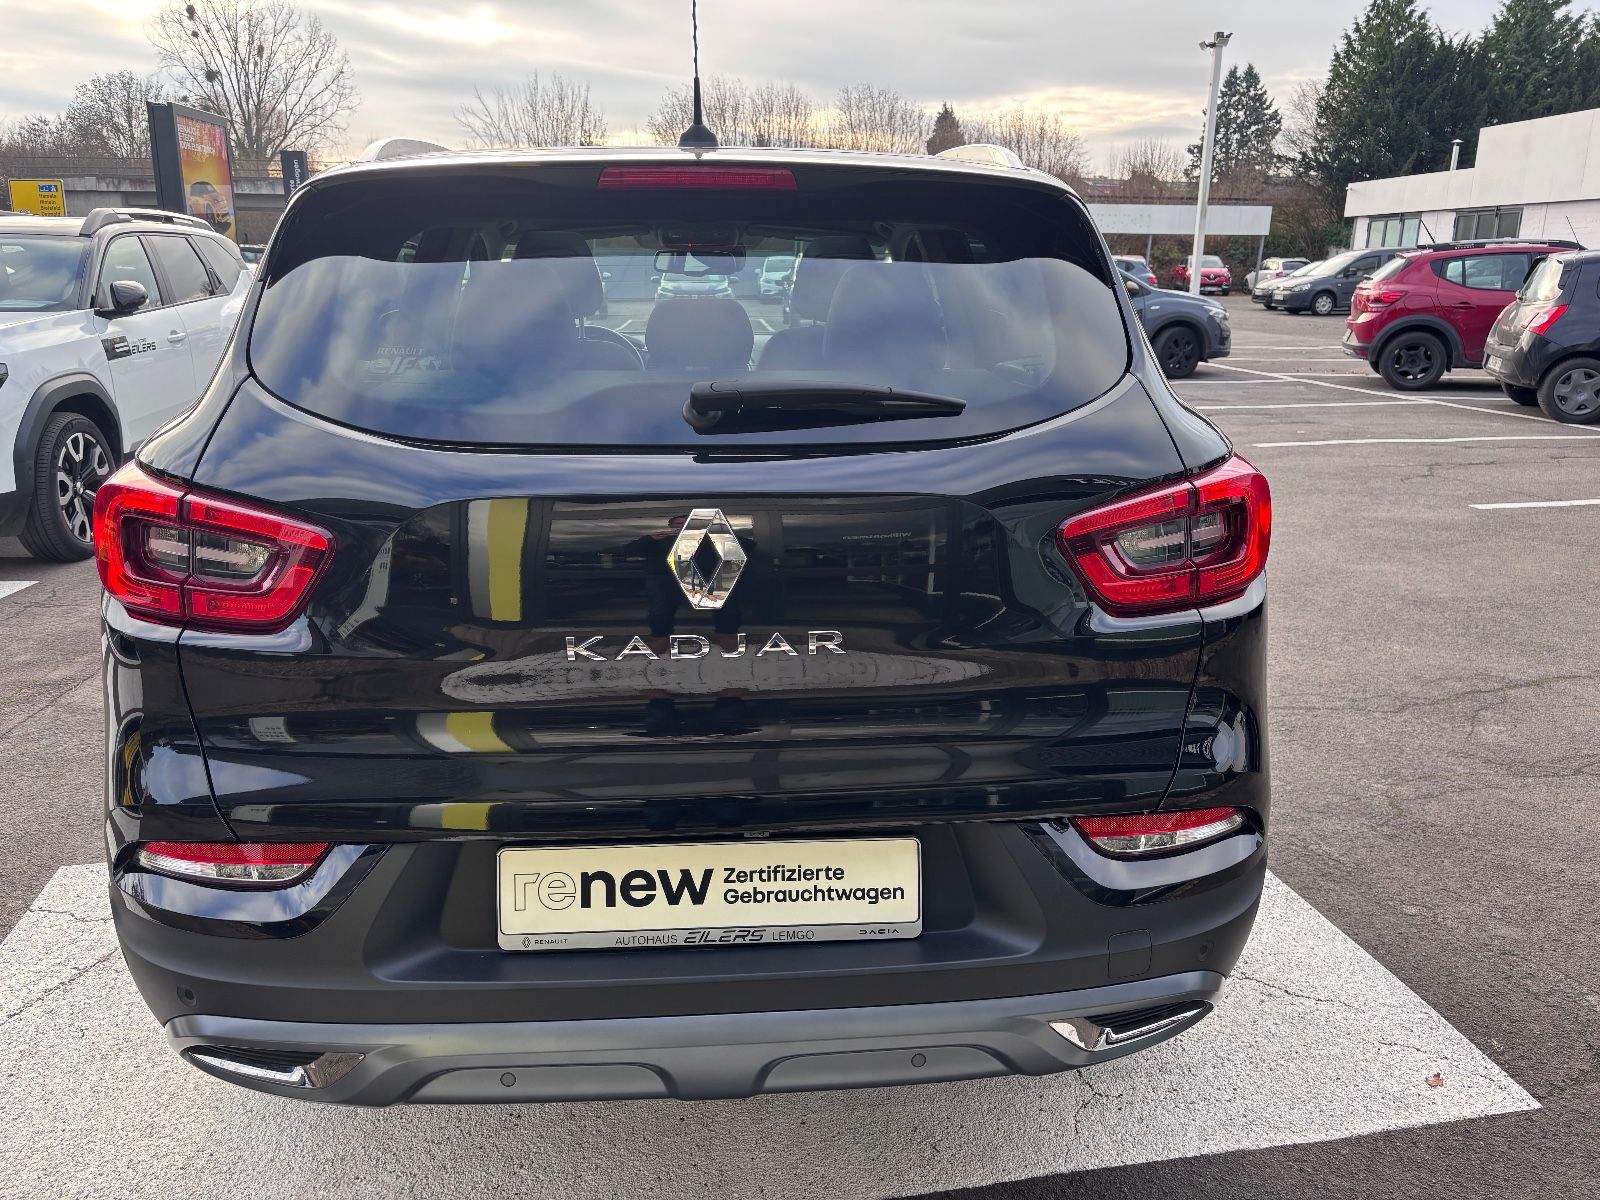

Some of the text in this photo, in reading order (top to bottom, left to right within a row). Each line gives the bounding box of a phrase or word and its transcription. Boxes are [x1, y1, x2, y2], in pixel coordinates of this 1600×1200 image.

[565, 630, 847, 661] KADJAR
[723, 864, 845, 884] Zertifizierte
[513, 868, 714, 912] renew
[723, 885, 905, 905] Gebrauchtwagen
[615, 929, 815, 946] AUTOHAUS EILERS LEMGO
